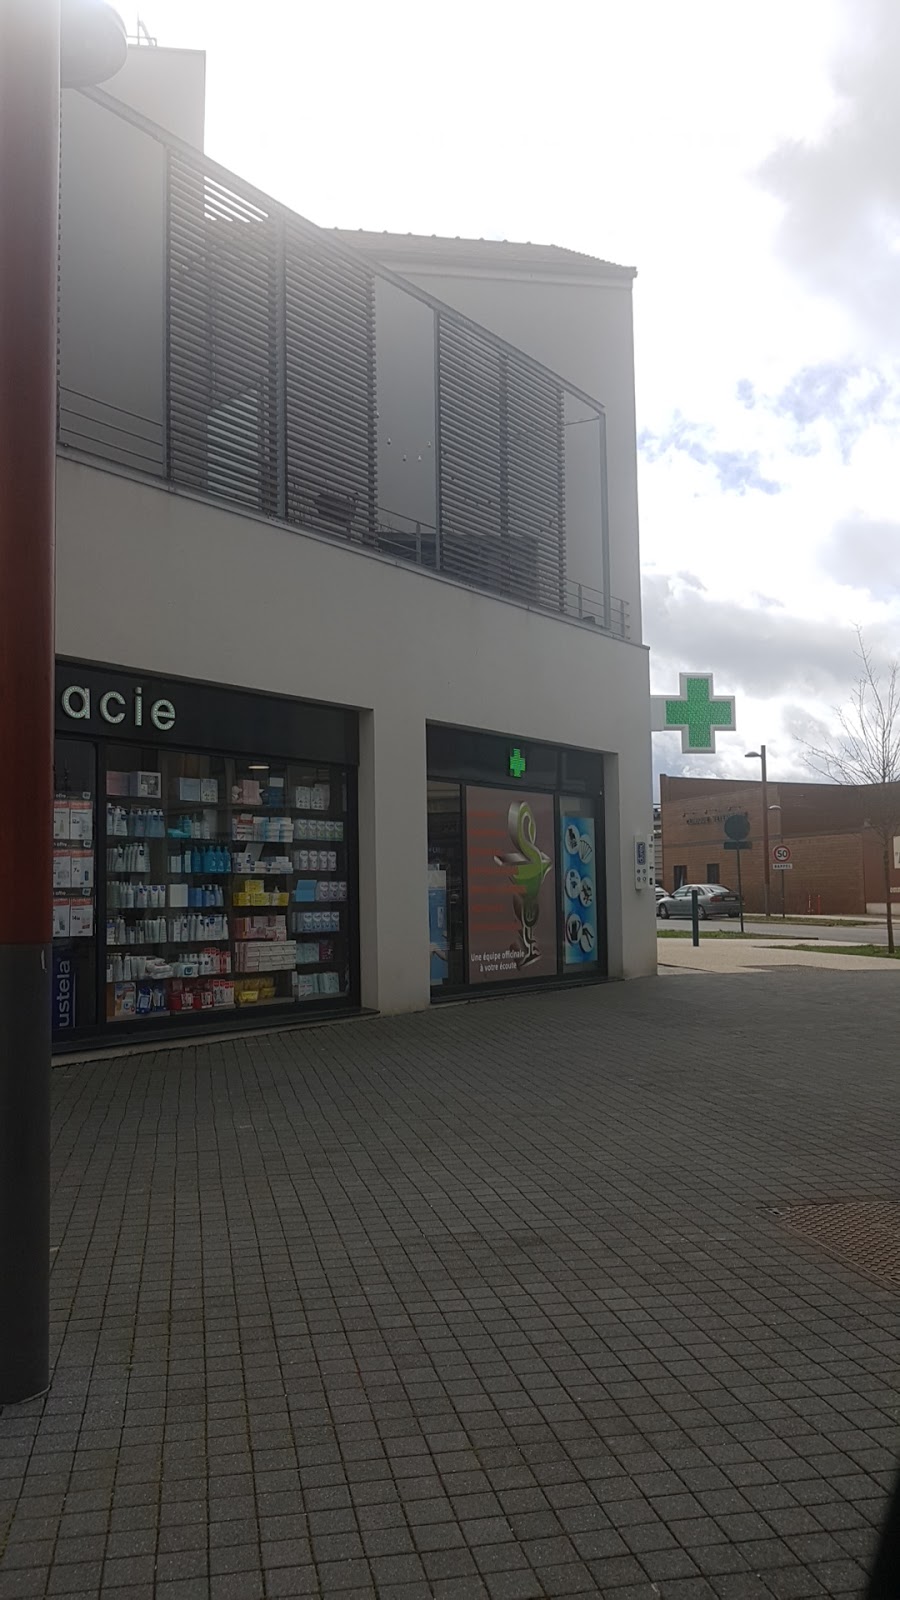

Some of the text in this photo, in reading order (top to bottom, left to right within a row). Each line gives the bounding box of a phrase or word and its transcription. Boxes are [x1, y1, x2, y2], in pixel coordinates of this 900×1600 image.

[61, 685, 176, 731] acie
[777, 849, 788, 858] 50
[470, 949, 525, 962] Une équipe officinale
[484, 963, 499, 972] votre
[499, 962, 517, 971] écoute
